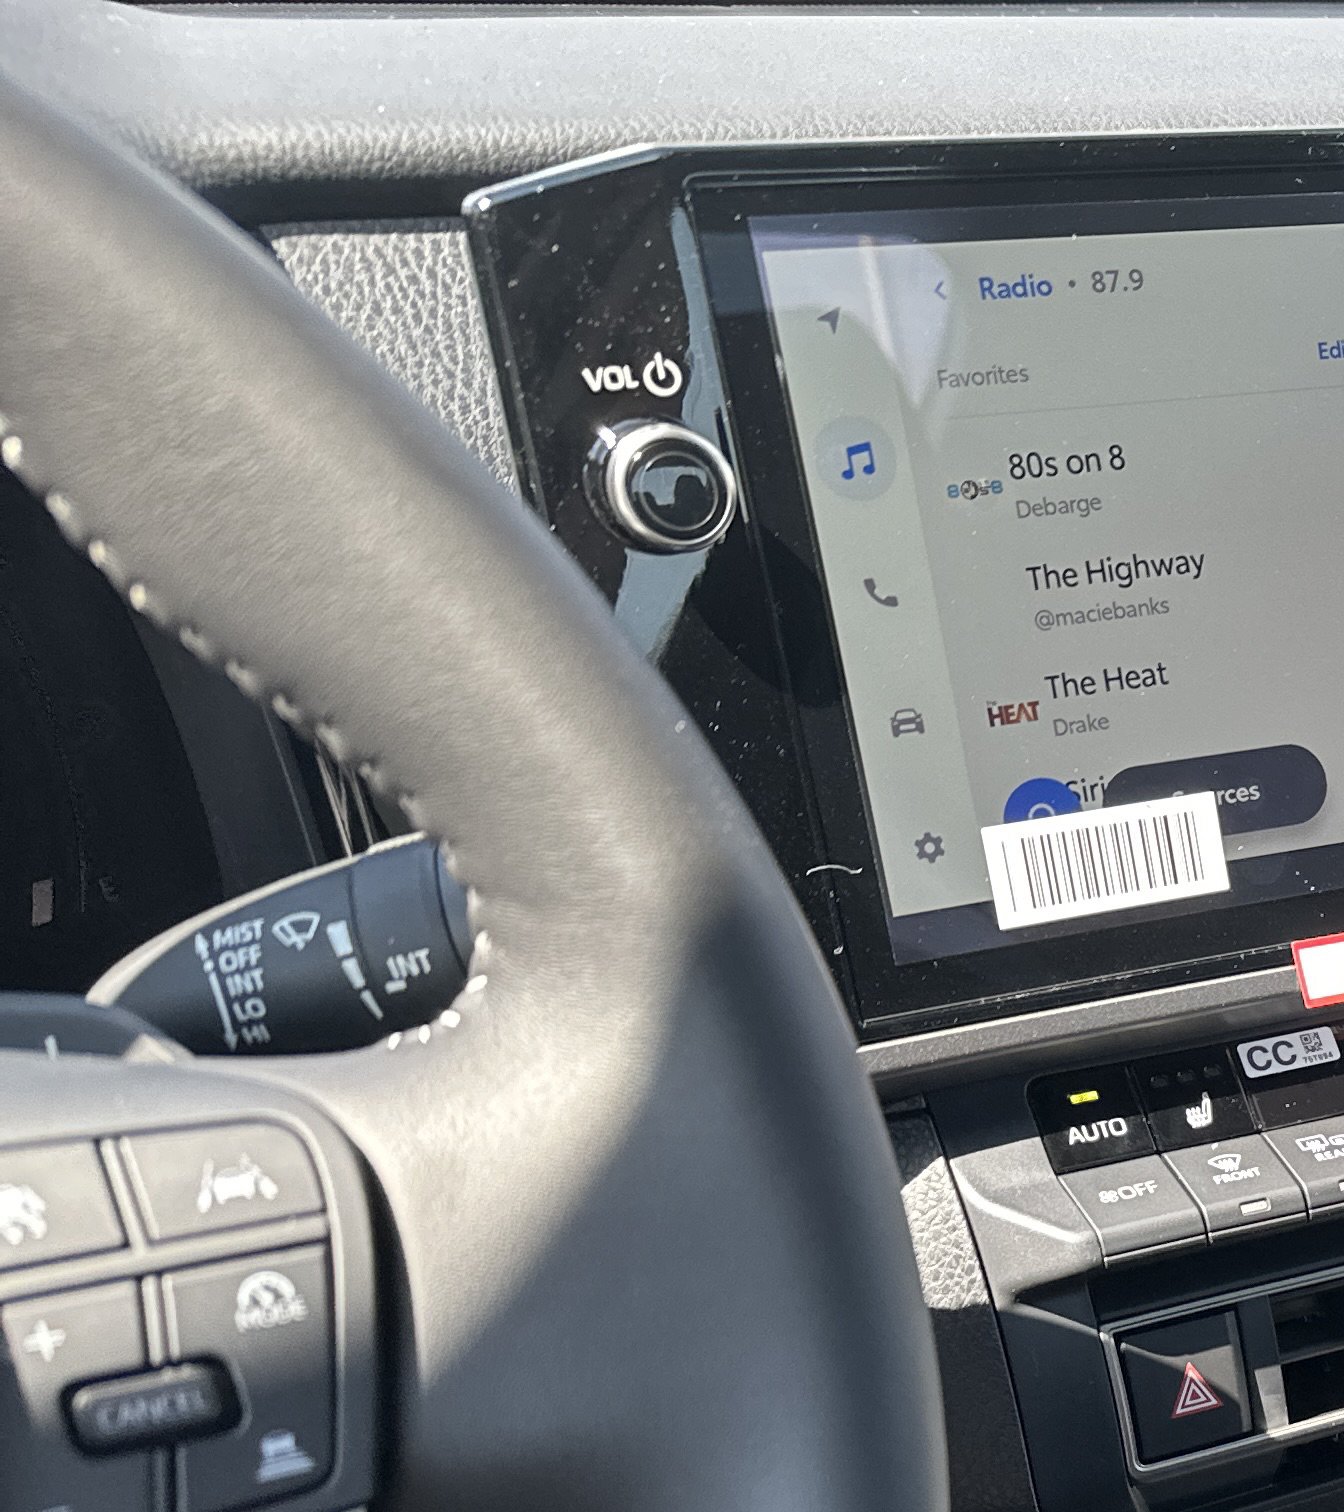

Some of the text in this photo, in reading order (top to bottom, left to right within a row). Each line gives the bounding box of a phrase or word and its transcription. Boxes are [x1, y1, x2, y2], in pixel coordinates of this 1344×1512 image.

[979, 269, 1145, 300] Radio 87.9
[582, 364, 639, 393] VOL
[937, 364, 1030, 389] Favorites
[1008, 444, 1126, 481] 80s on 8
[1015, 494, 1103, 519] Debarge
[1026, 552, 1206, 591] The Highway
[1034, 597, 1170, 631] @maciebanks
[1044, 661, 1170, 699] The Heat
[987, 701, 1039, 727] HEAT
[1053, 713, 1110, 737] Drake
[213, 918, 264, 951] MIST
[218, 943, 261, 974] OFF
[386, 947, 431, 979] INT
[225, 967, 264, 998] INT
[233, 997, 267, 1023] LO
[1247, 1040, 1297, 1071] CC
[1068, 1118, 1128, 1146] AUTO
[1118, 1180, 1158, 1200] OFF
[1213, 1167, 1261, 1185] FRONT
[234, 1296, 308, 1332] MODE
